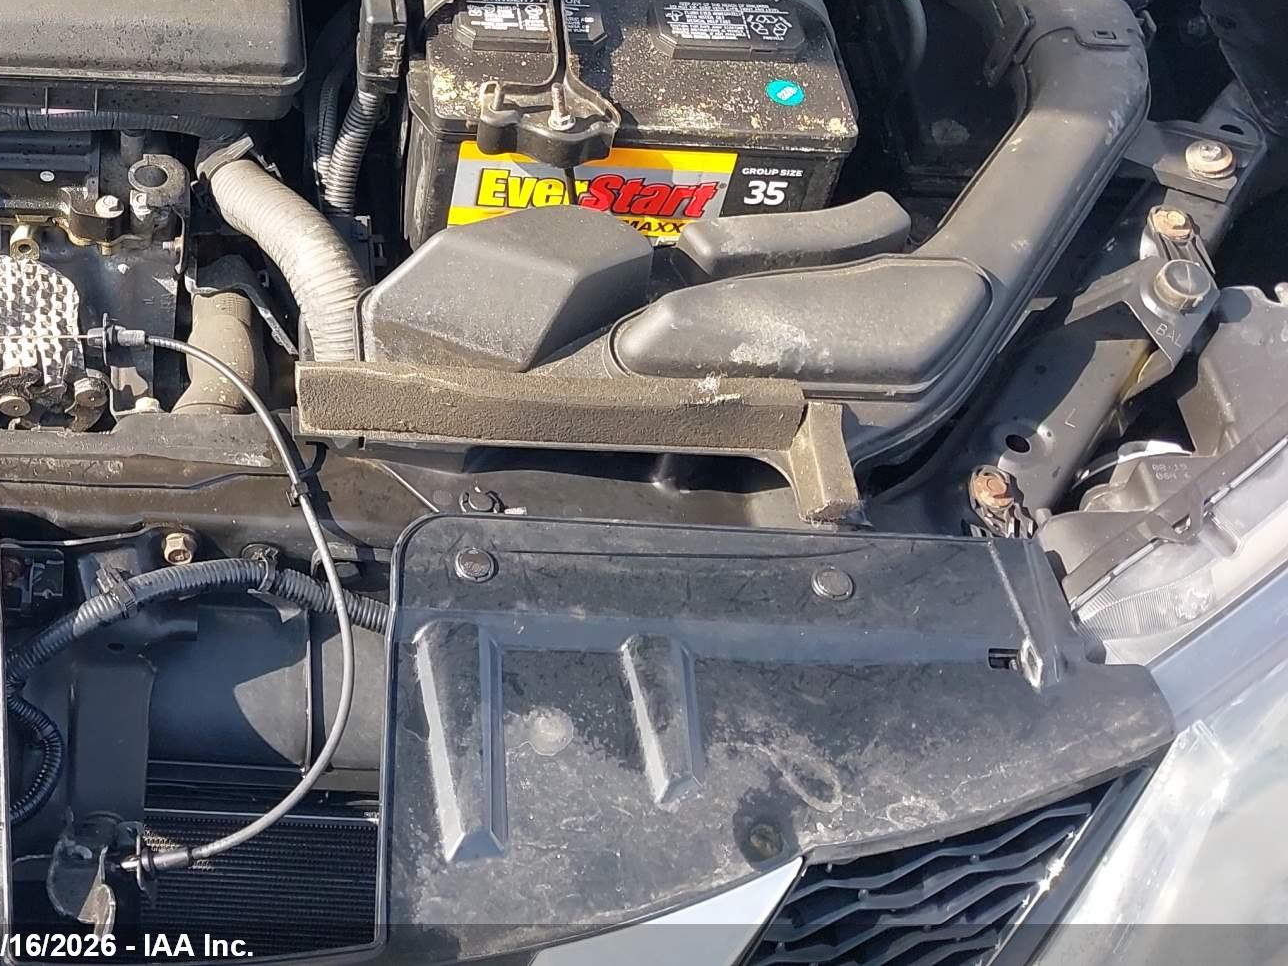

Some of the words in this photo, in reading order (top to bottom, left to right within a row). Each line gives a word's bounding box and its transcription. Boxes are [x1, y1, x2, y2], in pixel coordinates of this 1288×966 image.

[742, 167, 780, 176] GROUP
[781, 169, 804, 177] SIZE
[476, 167, 720, 218] EverStart
[743, 180, 789, 206] 35
[1155, 322, 1183, 348] BAL
